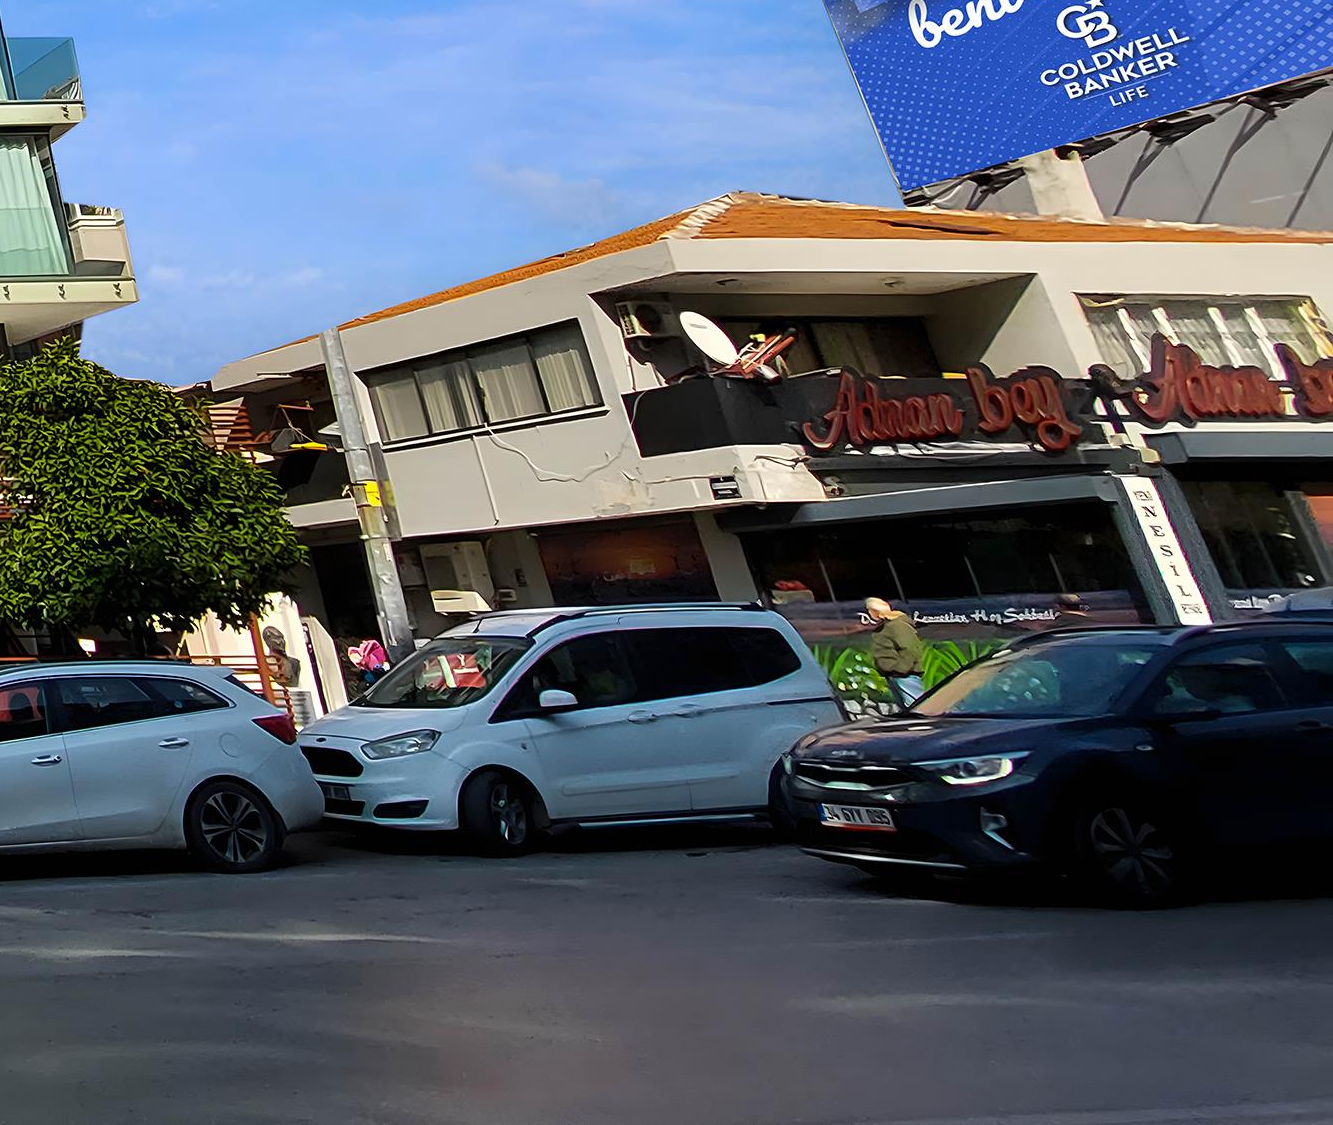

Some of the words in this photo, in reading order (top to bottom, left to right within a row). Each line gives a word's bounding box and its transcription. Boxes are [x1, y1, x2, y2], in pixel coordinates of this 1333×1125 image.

[1039, 27, 1191, 86] COLDWELL
[1063, 51, 1179, 100] BANKER
[1108, 85, 1150, 107] LIFE
[803, 369, 965, 450] Adnan
[967, 364, 1082, 453] bey
